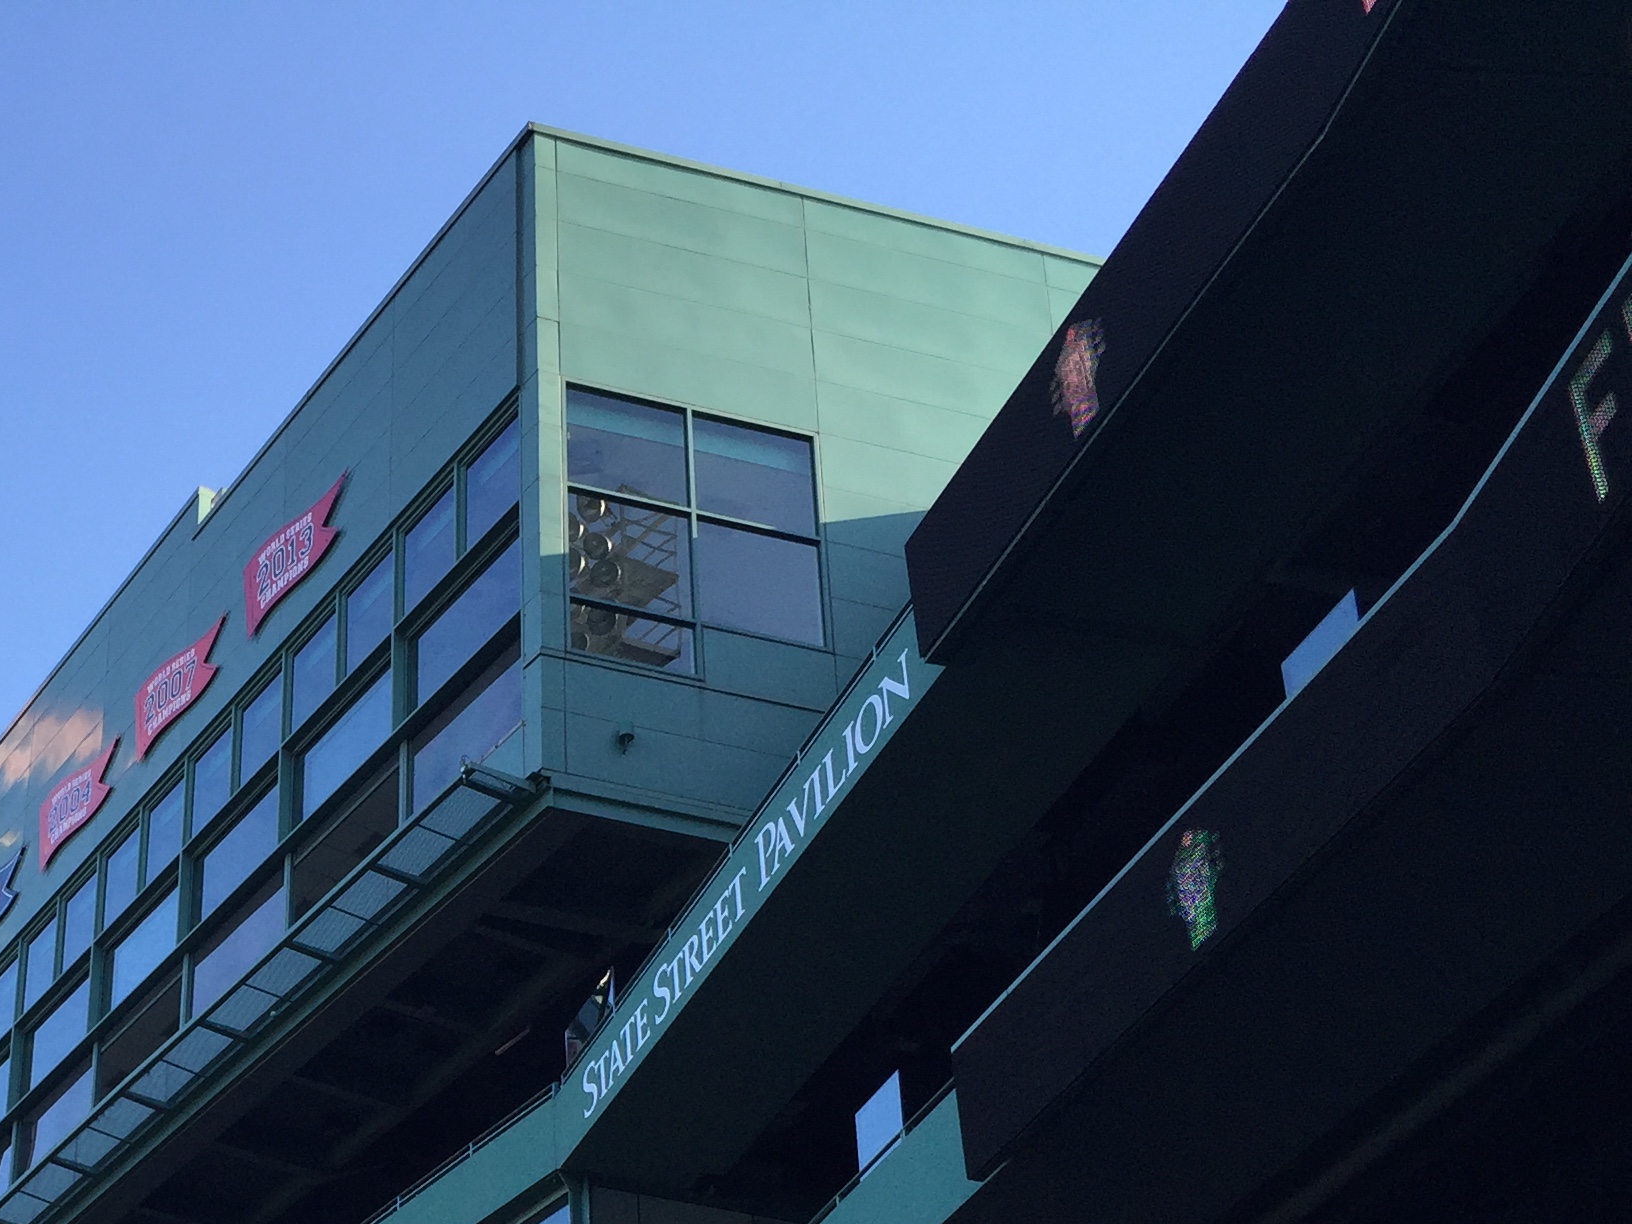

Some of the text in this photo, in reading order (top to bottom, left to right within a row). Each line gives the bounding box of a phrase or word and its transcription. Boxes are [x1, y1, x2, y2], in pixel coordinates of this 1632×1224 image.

[256, 522, 314, 602] 2013
[258, 512, 312, 565] WORLD SERIES
[260, 555, 309, 610] CHAMPIONS
[144, 655, 198, 728] 2007
[147, 648, 195, 694] WORLD SERIES
[147, 689, 192, 737] CHAMPIONS
[48, 777, 92, 838] 2004
[50, 806, 87, 845] CHAMPIONS
[581, 647, 911, 1118] STATE STREET PAVILION
